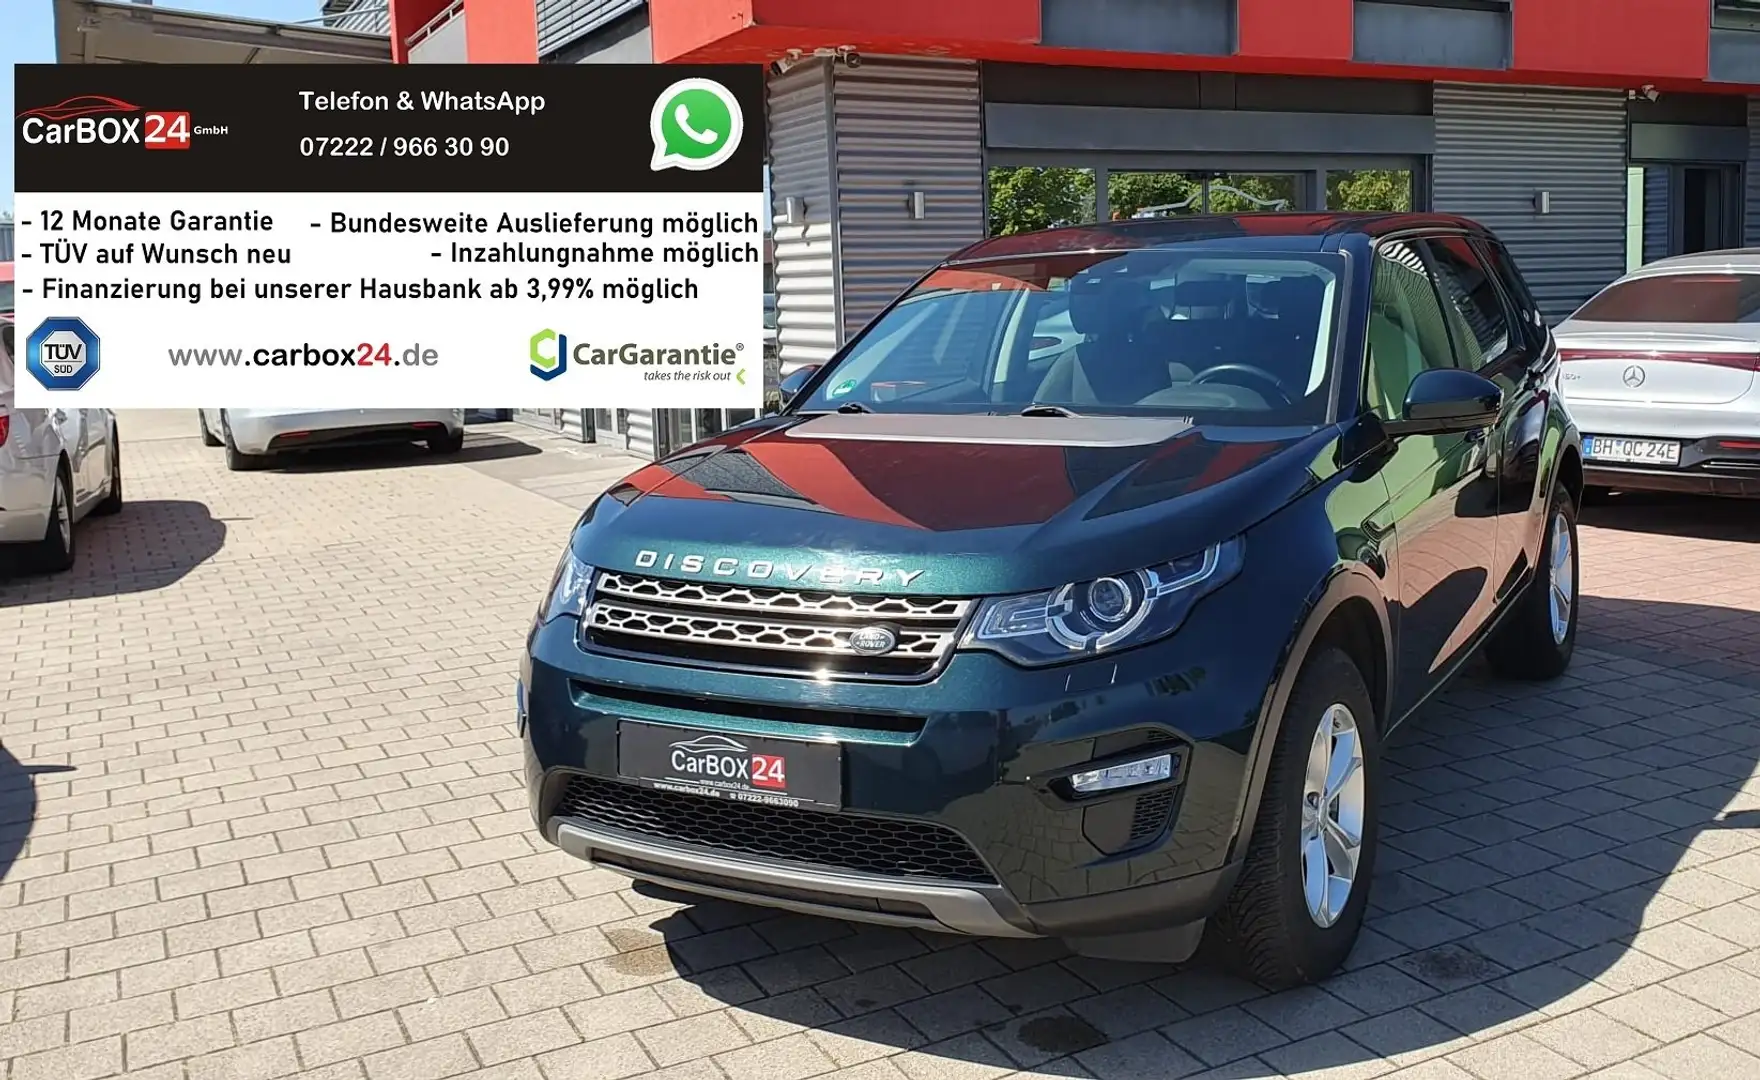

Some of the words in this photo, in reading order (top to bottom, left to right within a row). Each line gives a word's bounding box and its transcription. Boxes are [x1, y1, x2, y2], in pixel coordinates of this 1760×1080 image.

[1593, 439, 1613, 455] BH
[1622, 440, 1643, 457] QC
[1646, 441, 1677, 460] 24E
[635, 550, 926, 588] DISCOVERY
[859, 640, 886, 648] ROVER
[653, 782, 721, 798] www.carbox24.de
